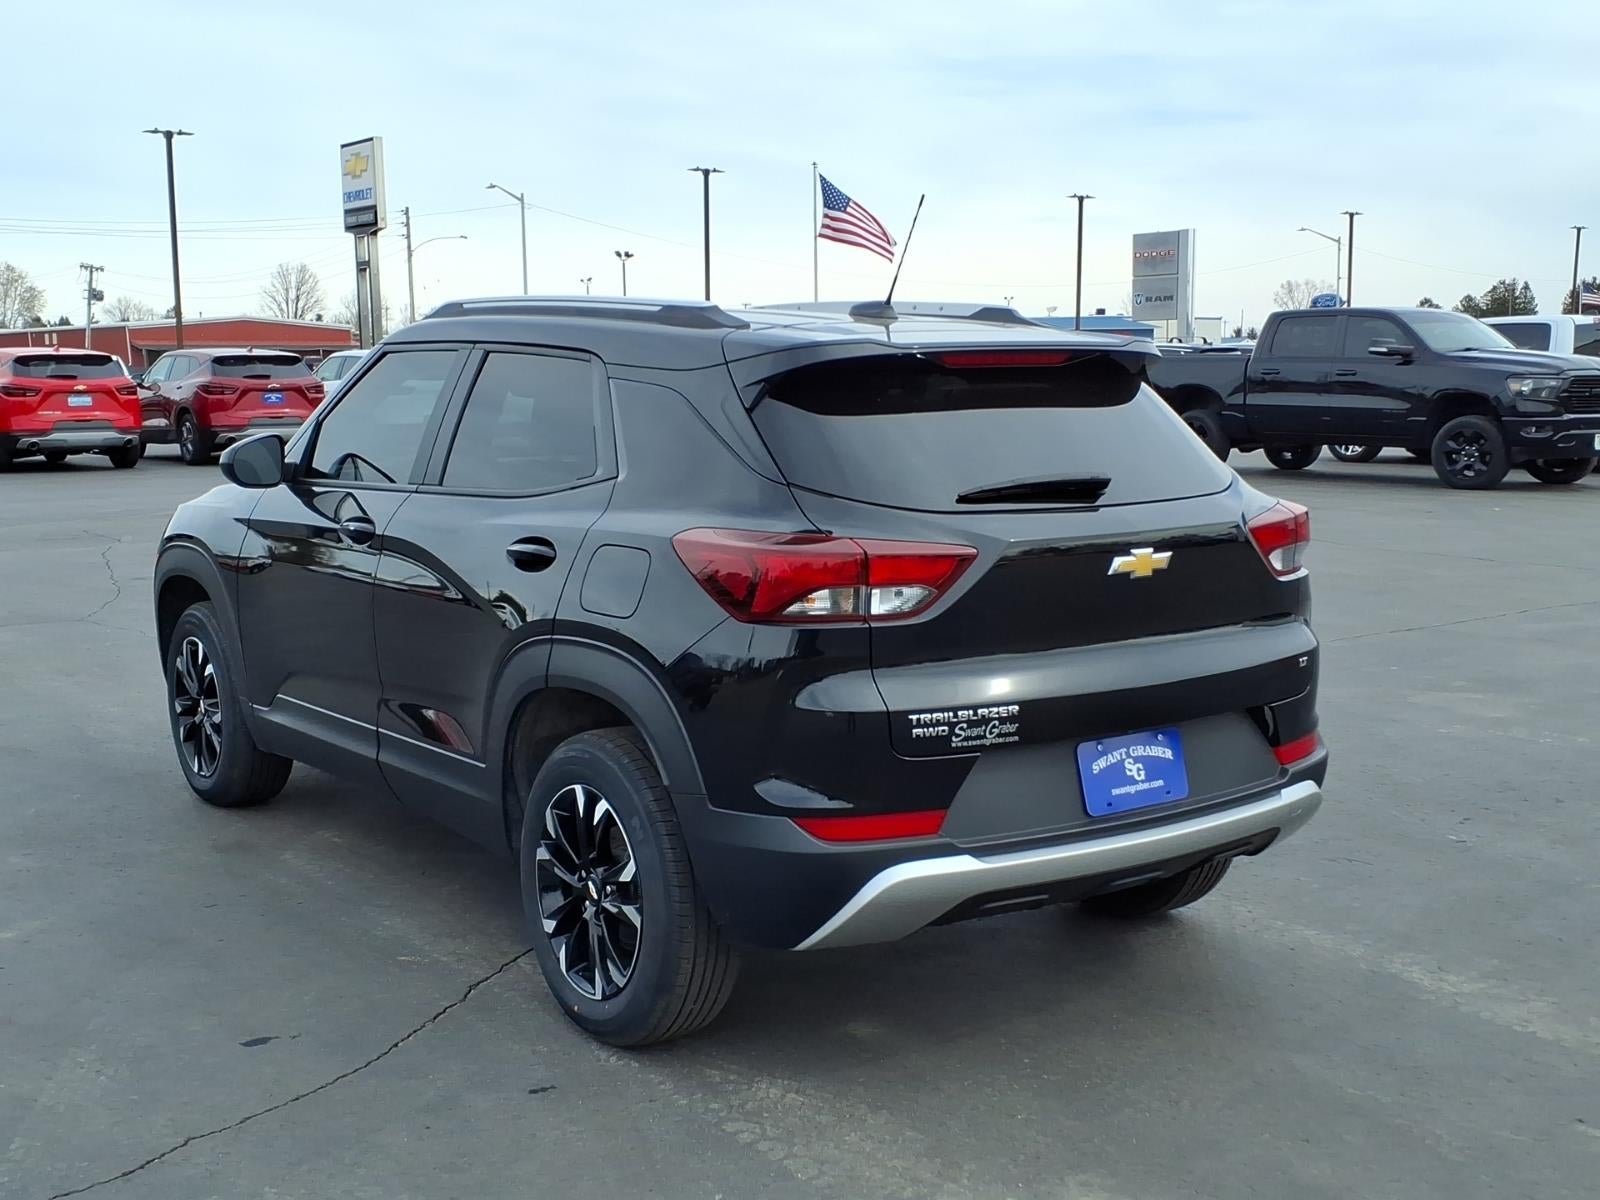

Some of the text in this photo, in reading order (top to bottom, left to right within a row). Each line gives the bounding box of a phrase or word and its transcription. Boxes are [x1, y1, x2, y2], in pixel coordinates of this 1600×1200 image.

[1135, 250, 1176, 258] DODGE
[1145, 295, 1174, 303] RAM
[908, 705, 1020, 725] TRAILBLAZER
[912, 726, 949, 738] AWD
[951, 720, 1019, 741] Swant Graber
[951, 735, 1020, 747] www.swantgraber.com
[1092, 745, 1174, 774] SWANT GRABER
[1124, 758, 1146, 780] SG
[1111, 779, 1165, 796] swantgraber.com
